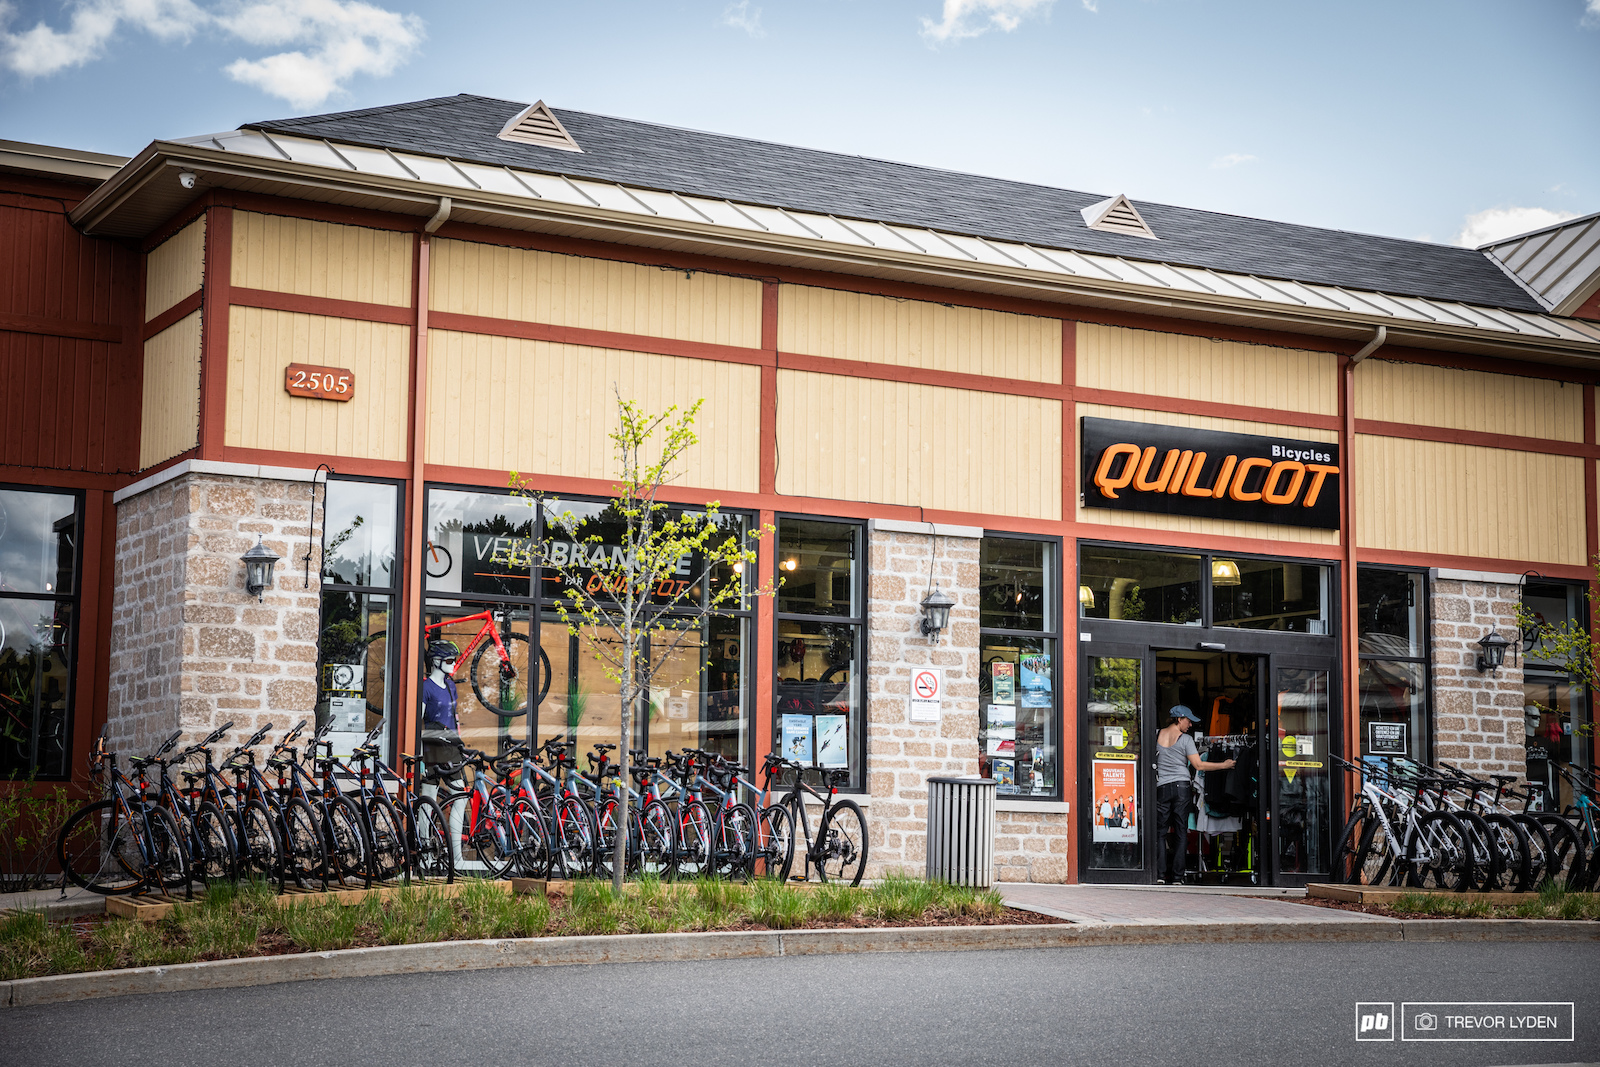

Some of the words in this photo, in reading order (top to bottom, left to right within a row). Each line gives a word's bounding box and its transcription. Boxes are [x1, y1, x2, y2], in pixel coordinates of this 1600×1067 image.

[292, 370, 349, 394] 2505
[1271, 444, 1331, 463] Bicycles
[1093, 443, 1340, 507] QUILICOT
[565, 577, 583, 587] PAR
[586, 574, 690, 597] QUIOT
